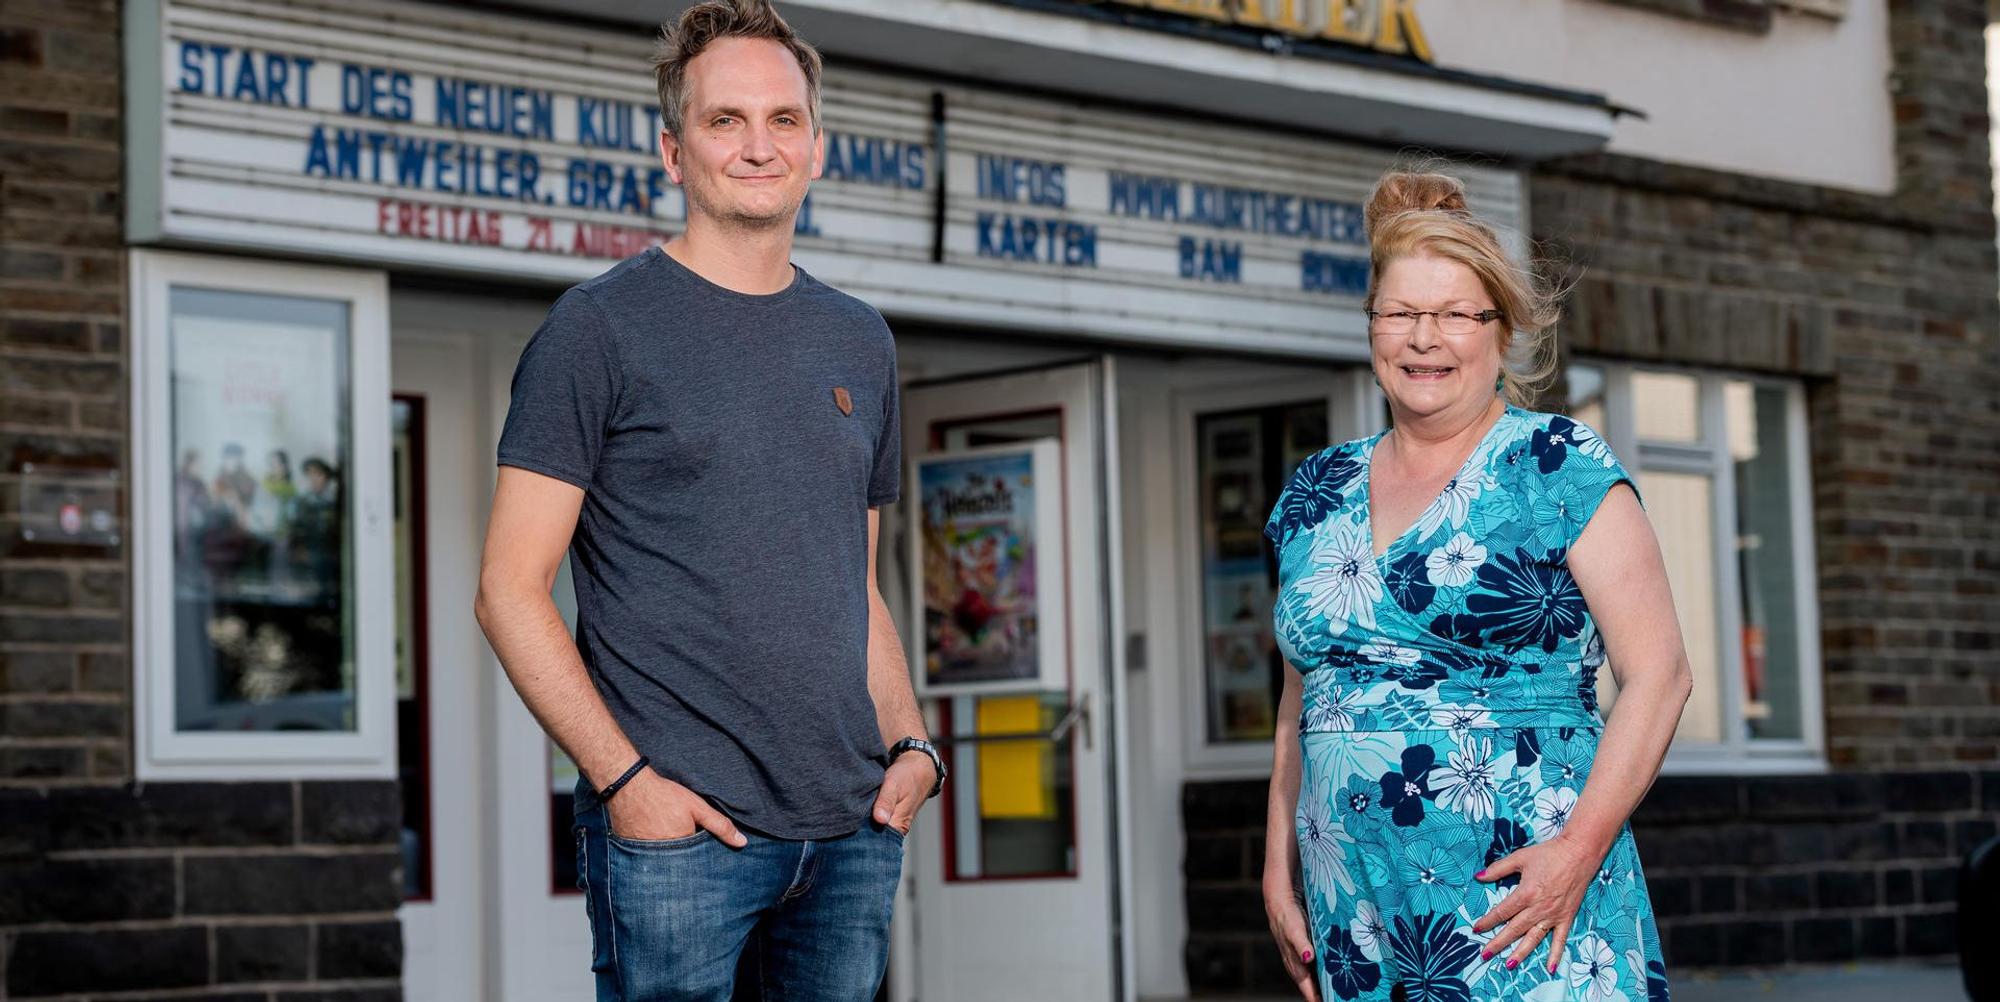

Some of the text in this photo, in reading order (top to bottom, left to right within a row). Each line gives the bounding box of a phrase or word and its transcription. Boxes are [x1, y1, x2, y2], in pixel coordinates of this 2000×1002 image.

[179, 40, 316, 108] START
[341, 63, 413, 123] DES
[434, 77, 554, 142] NEUEN
[568, 157, 666, 219] GRAF
[977, 153, 1065, 209] INFOS
[377, 198, 503, 247] FREITAG
[527, 213, 564, 255] 21.
[977, 210, 1097, 269] KARTEN
[1178, 233, 1242, 285] BAM
